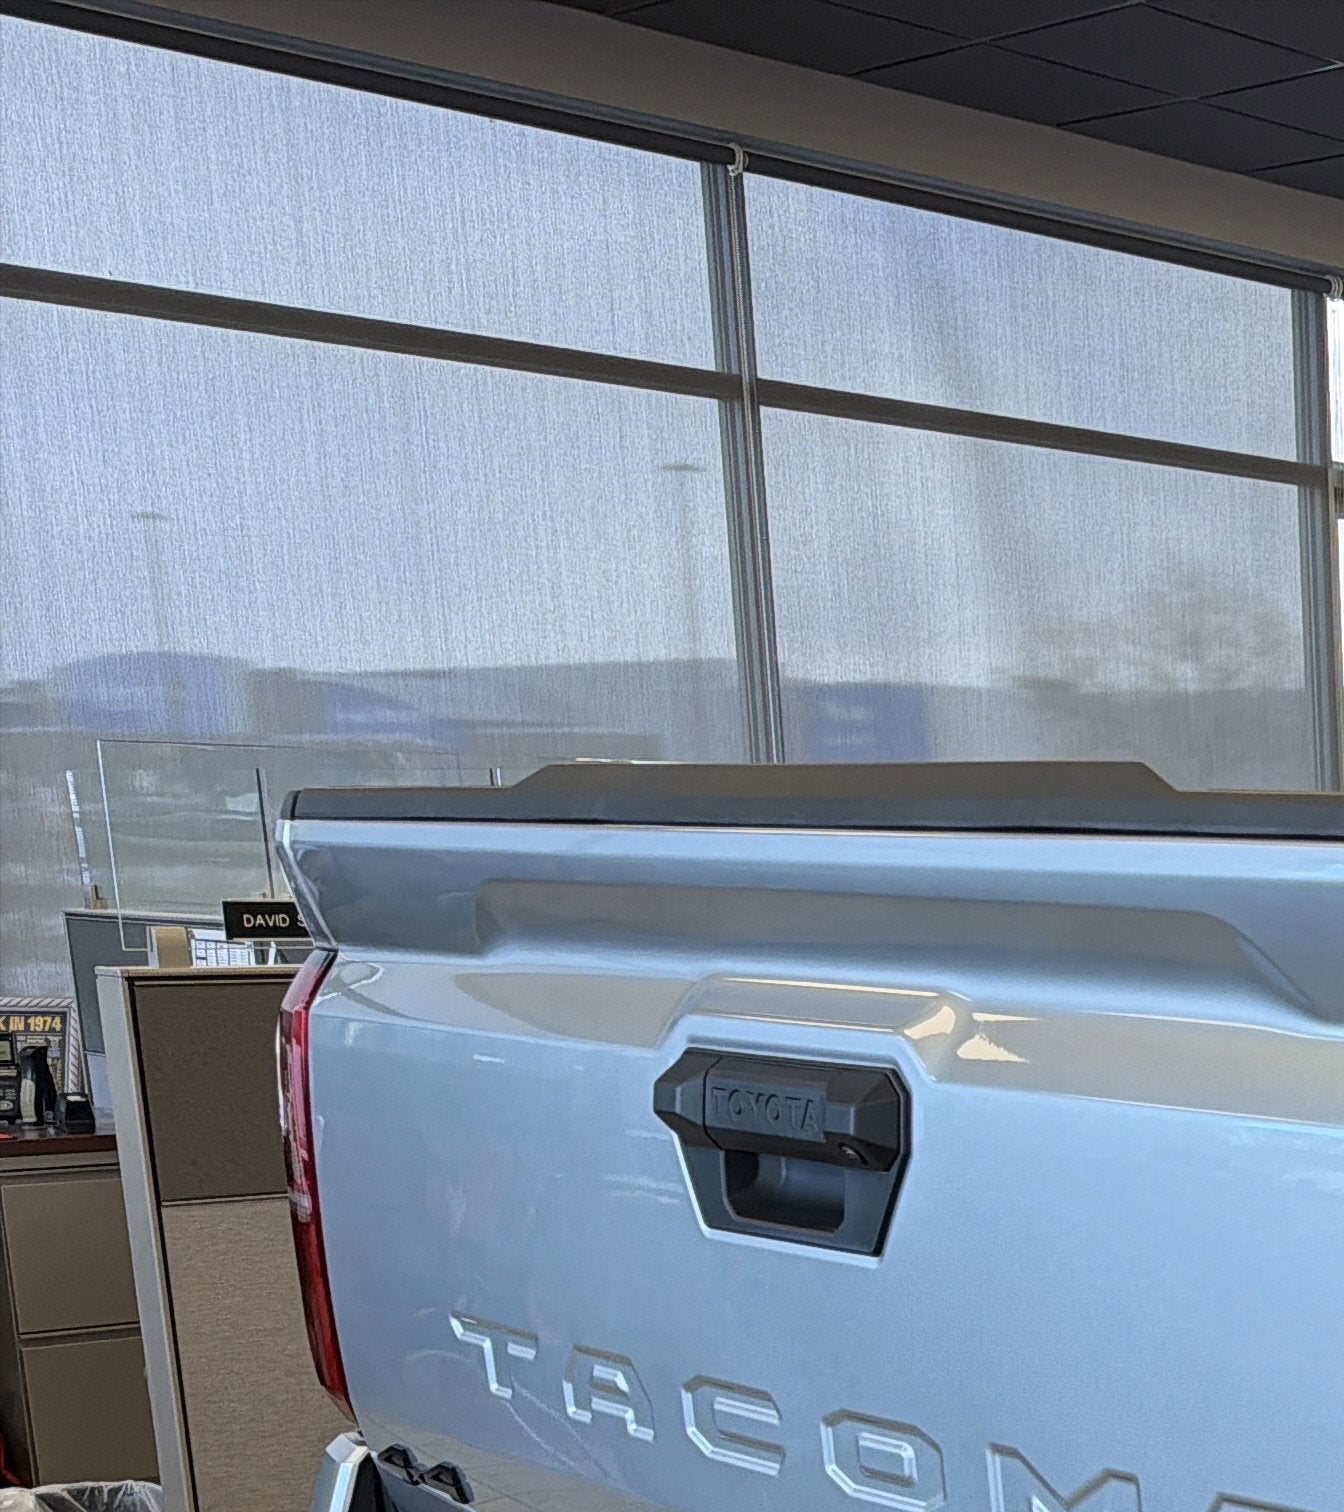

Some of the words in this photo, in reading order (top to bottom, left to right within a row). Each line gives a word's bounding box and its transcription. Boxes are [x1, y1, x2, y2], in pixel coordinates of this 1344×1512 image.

[243, 914, 290, 928] DAVID
[27, 1016, 62, 1032] 1974
[711, 1087, 823, 1133] TOYOTA
